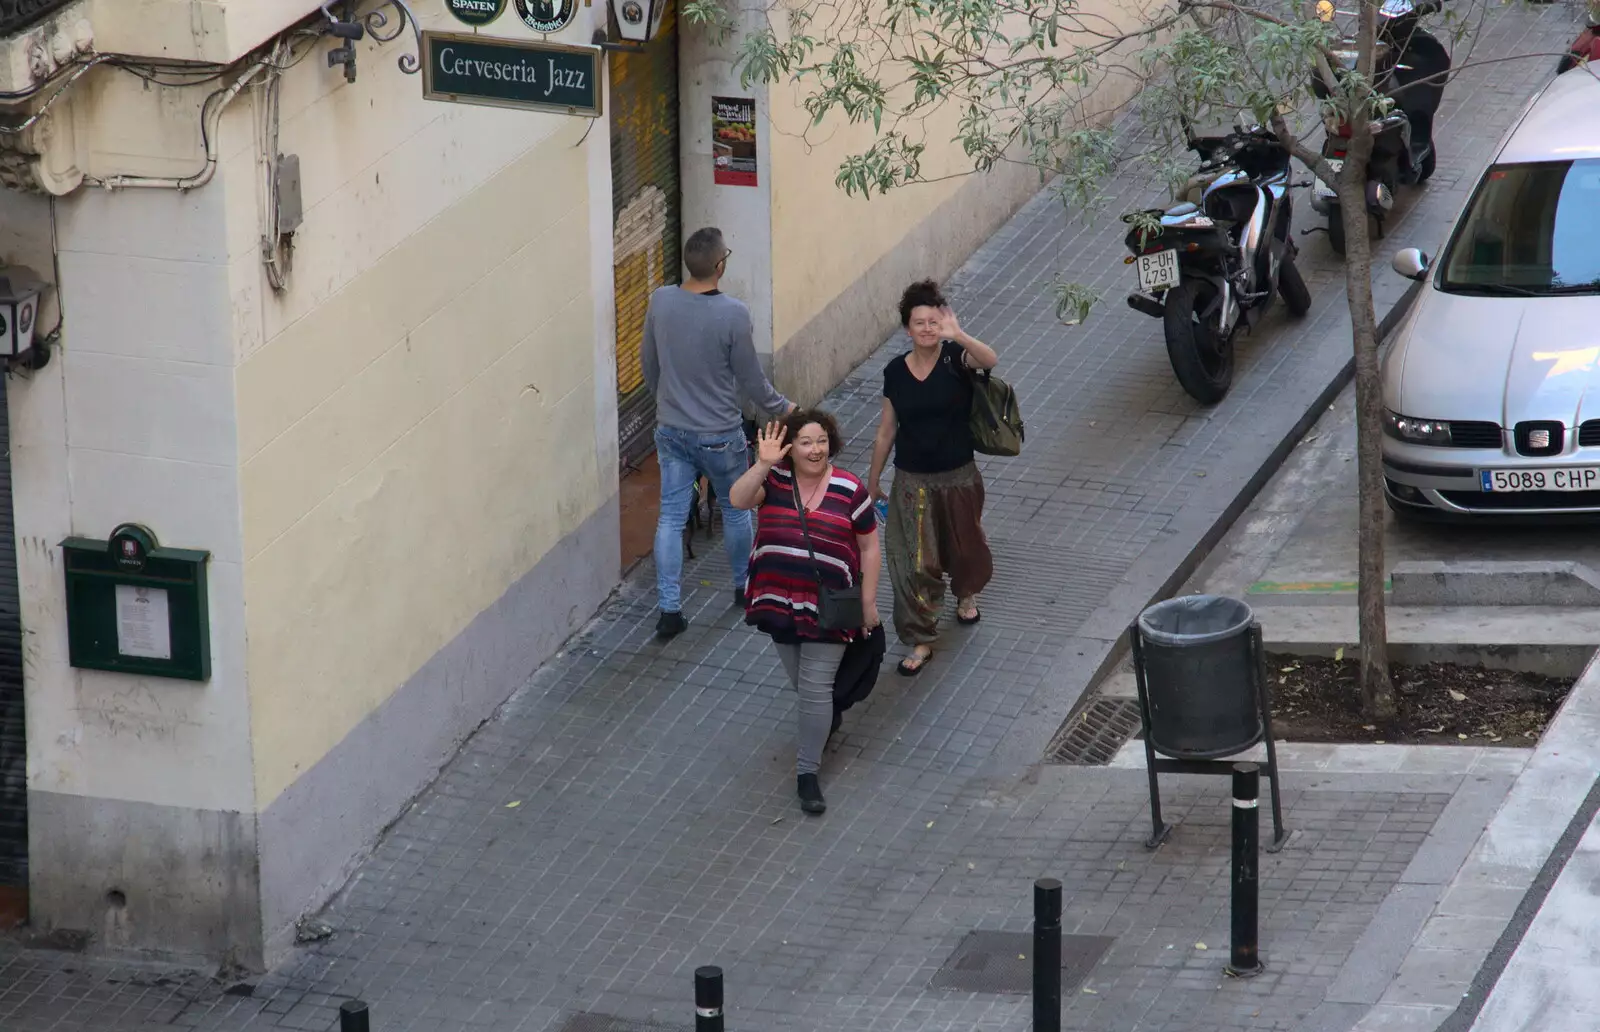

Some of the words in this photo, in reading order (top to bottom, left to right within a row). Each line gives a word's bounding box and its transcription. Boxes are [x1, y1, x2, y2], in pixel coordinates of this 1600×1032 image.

[452, 0, 495, 11] SPATEN
[439, 47, 536, 84] Cerveseria
[544, 58, 586, 96] Jazz
[1142, 251, 1174, 271] B-UH
[1145, 267, 1173, 285] 4791
[1495, 472, 1546, 489] 5089
[1554, 470, 1596, 488] CHP
